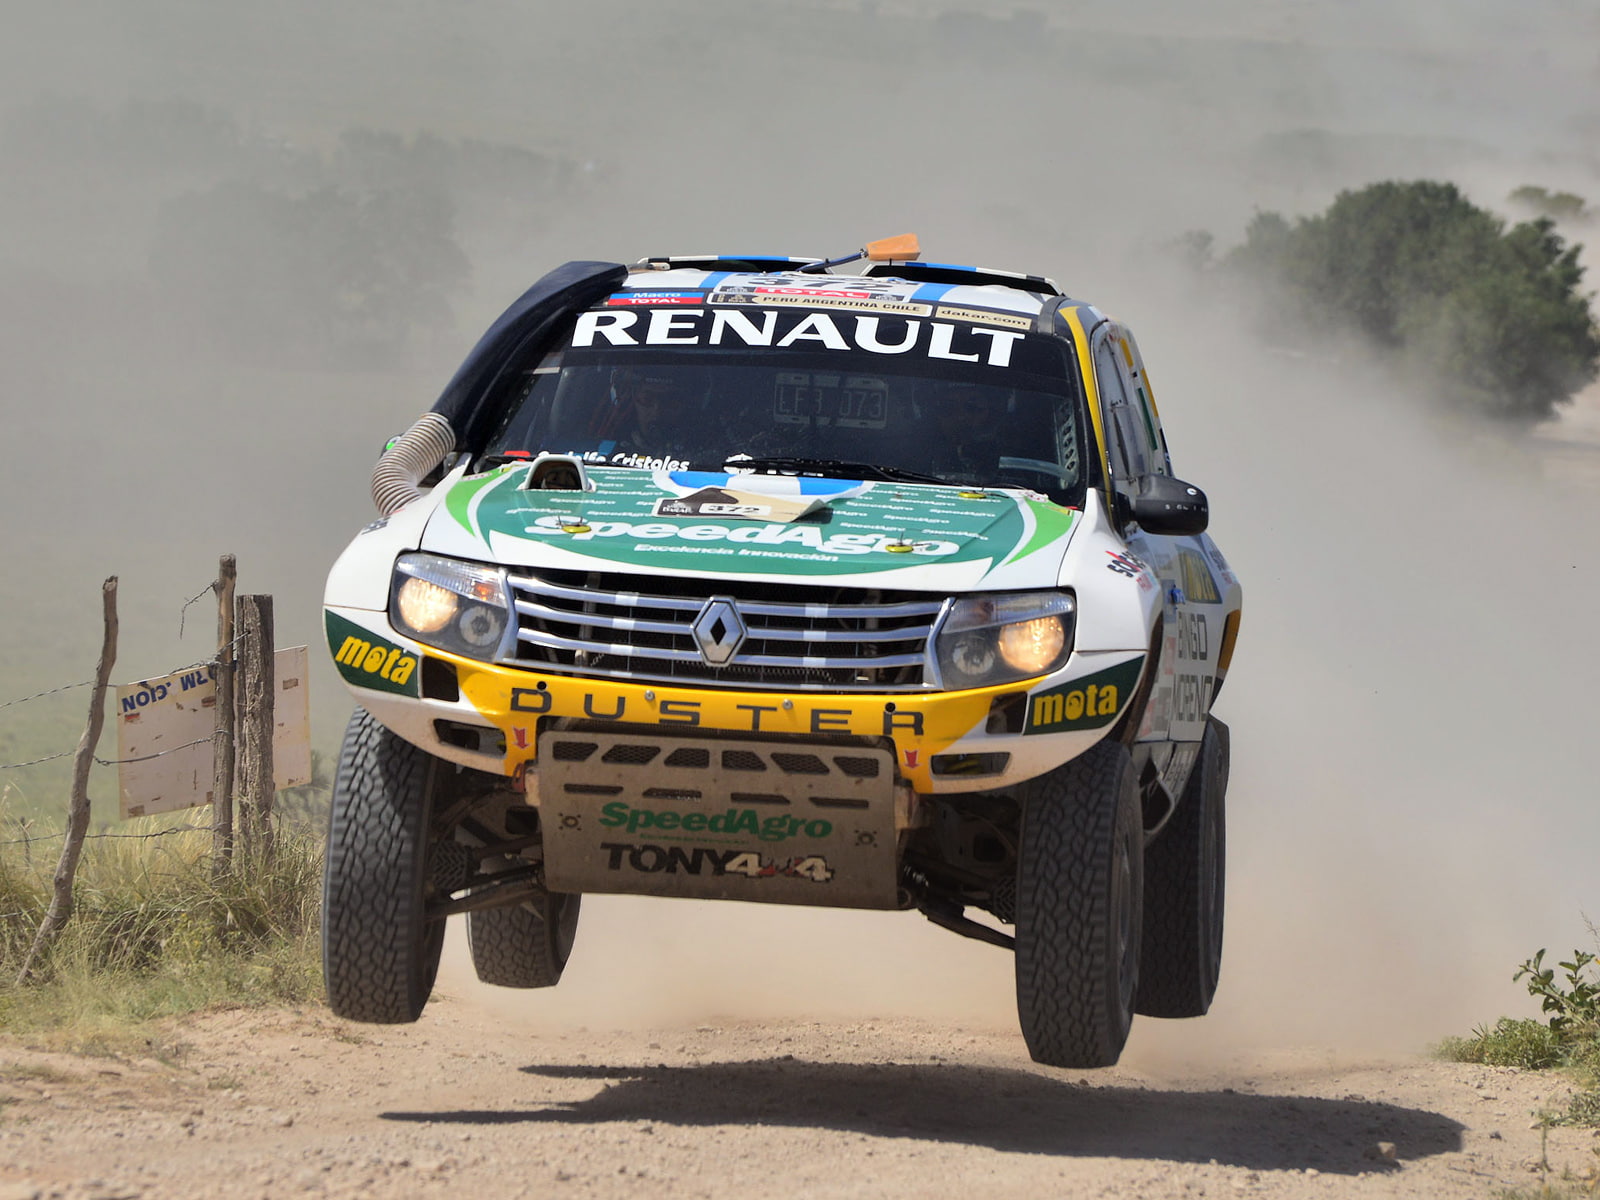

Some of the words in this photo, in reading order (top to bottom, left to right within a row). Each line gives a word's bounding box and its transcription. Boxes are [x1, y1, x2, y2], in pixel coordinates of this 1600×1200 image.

[764, 287, 866, 299] TOTAL
[802, 298, 878, 309] ARGENTINA
[882, 303, 921, 312] CHILE
[941, 309, 1027, 327] dakar.com
[571, 309, 1026, 368] RENAULT
[612, 452, 690, 472] Cristales
[707, 505, 761, 514] 372
[524, 515, 960, 558] SpeedAgro
[633, 543, 735, 556] Excelencia
[738, 547, 839, 562] Innovación
[335, 635, 417, 686] mota
[510, 687, 924, 736] DUSTER
[1033, 684, 1119, 727] mota
[598, 801, 834, 842] SpeedAgro
